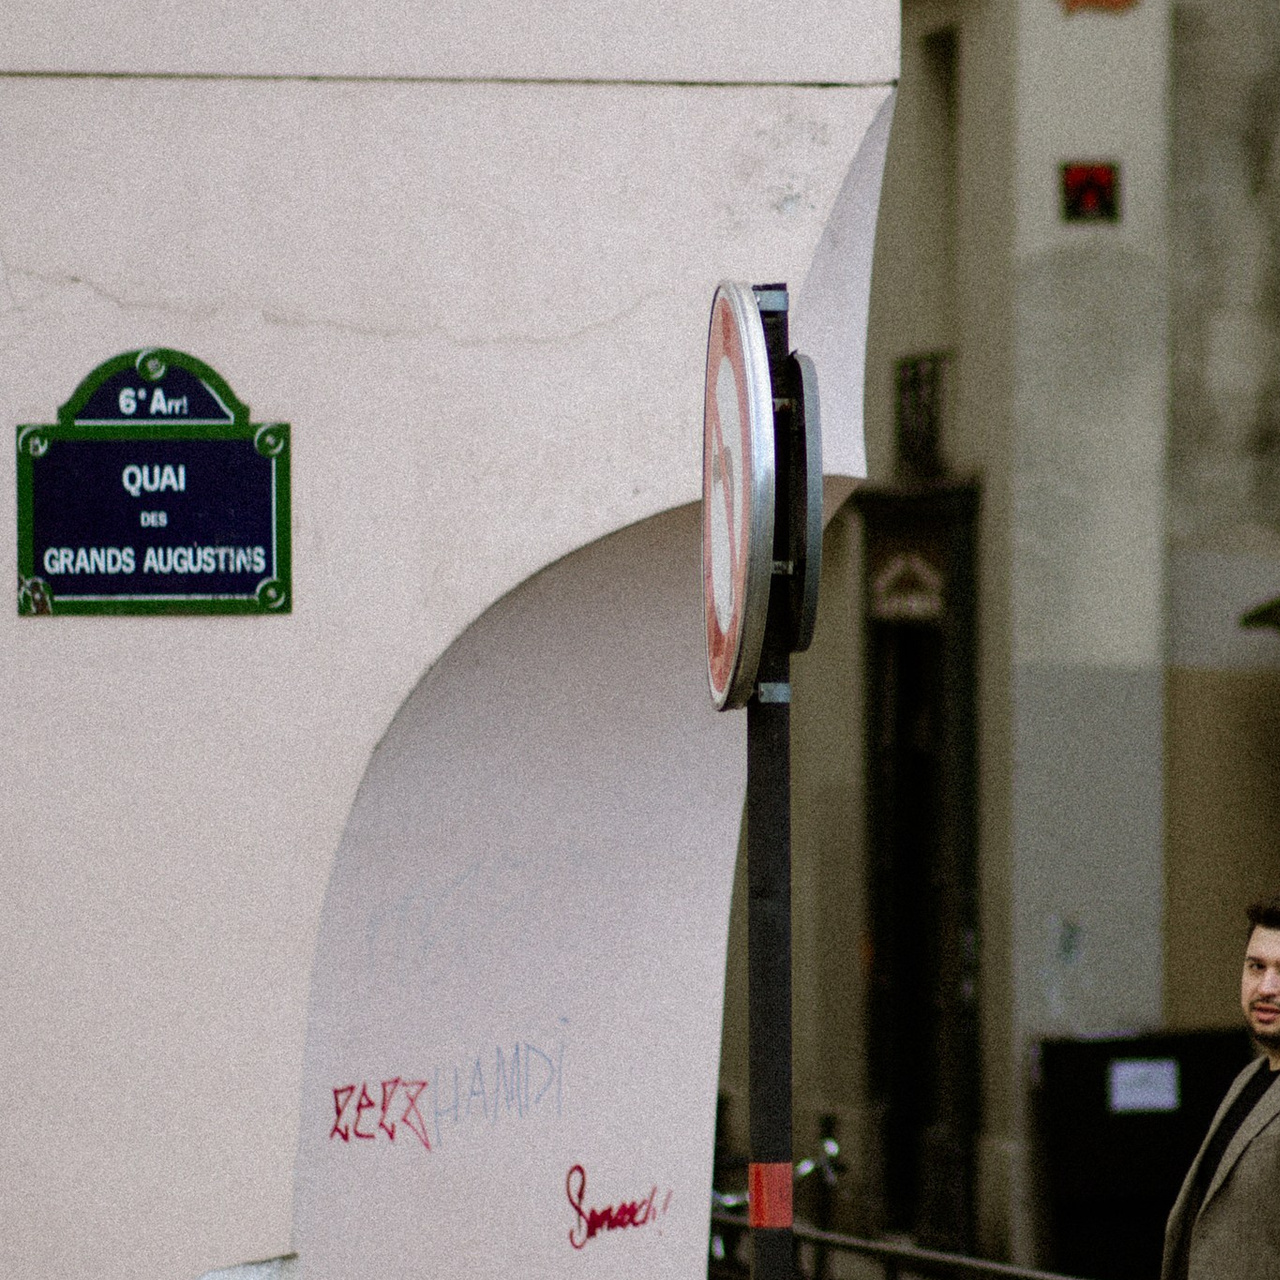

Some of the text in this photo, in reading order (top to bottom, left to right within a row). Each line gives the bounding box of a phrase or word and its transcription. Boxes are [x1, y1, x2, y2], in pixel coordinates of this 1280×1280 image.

[122, 464, 186, 497] QUAI
[140, 511, 168, 527] DES
[43, 546, 266, 574] GRANDS AUGUSTINS
